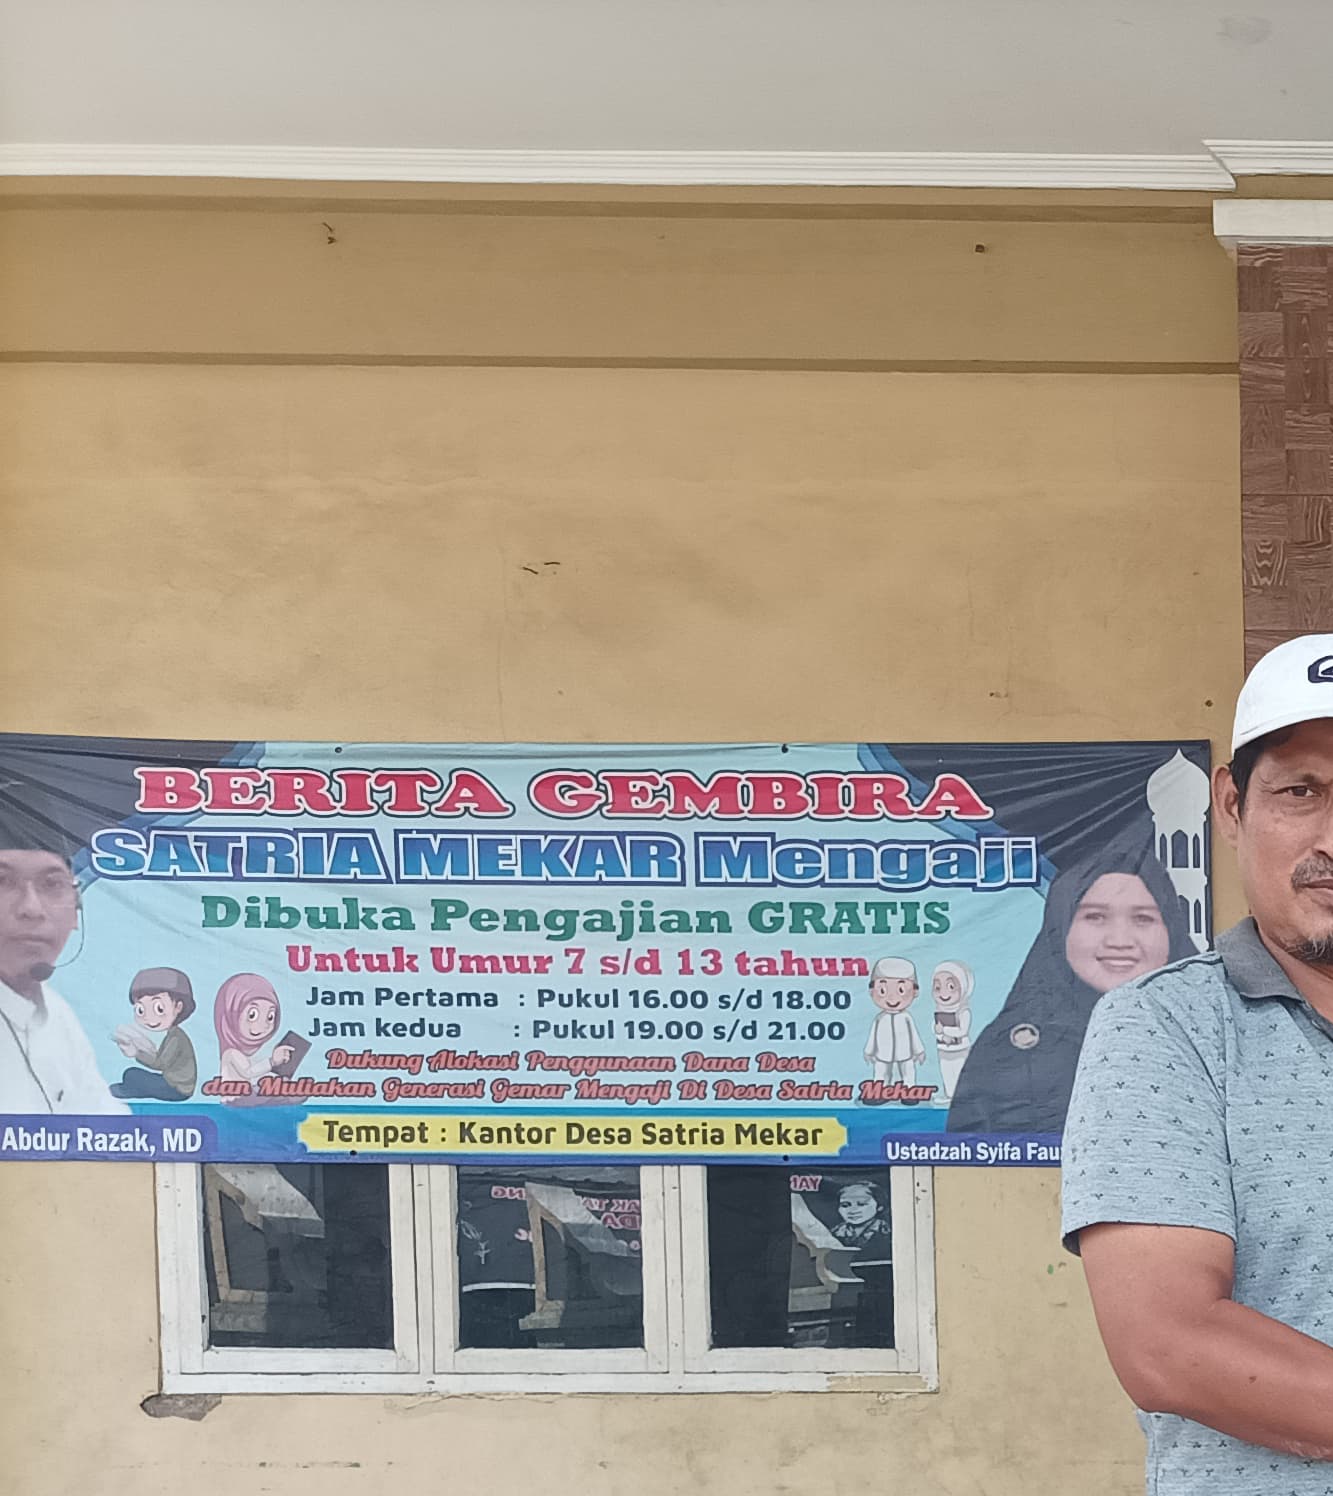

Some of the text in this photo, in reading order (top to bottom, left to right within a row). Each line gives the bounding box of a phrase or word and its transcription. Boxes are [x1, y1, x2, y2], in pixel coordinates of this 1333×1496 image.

[134, 767, 994, 820] BERITA GEMBIRA
[92, 829, 1040, 891] SATRIA MEKAR Mengaji
[202, 896, 950, 941] Dibuka Pengajian GRATIS
[286, 946, 869, 978] Untuk Umur 7 s/d 13 tahun
[306, 987, 365, 1007] Jam
[375, 987, 499, 1008] Pertama
[538, 988, 619, 1009] Pukul
[628, 989, 710, 1010] 16.00
[718, 988, 764, 1013] s/d
[772, 990, 852, 1011] 18.00
[308, 1018, 365, 1038] Jam
[375, 1018, 462, 1038] kedua
[533, 1019, 614, 1040] Pukul
[623, 1020, 704, 1041] 19.00
[712, 1019, 758, 1044] s/d
[767, 1021, 846, 1042] 21.00
[326, 1049, 816, 1076] Dukung Alokasi Penggunaan Dana Desa
[202, 1076, 938, 1105] dan Muliakan Generasi Gemar Mengaji Di Desa Satria Mekar
[2, 1127, 202, 1156] Abdur Razak, MD
[323, 1120, 429, 1147] Tempat
[459, 1121, 557, 1144] Kantor
[566, 1122, 632, 1145] Desa
[641, 1122, 725, 1146] Satria
[735, 1123, 824, 1146] Mekar
[886, 1142, 971, 1161] Ustadzah
[976, 1141, 1021, 1164] Syifa
